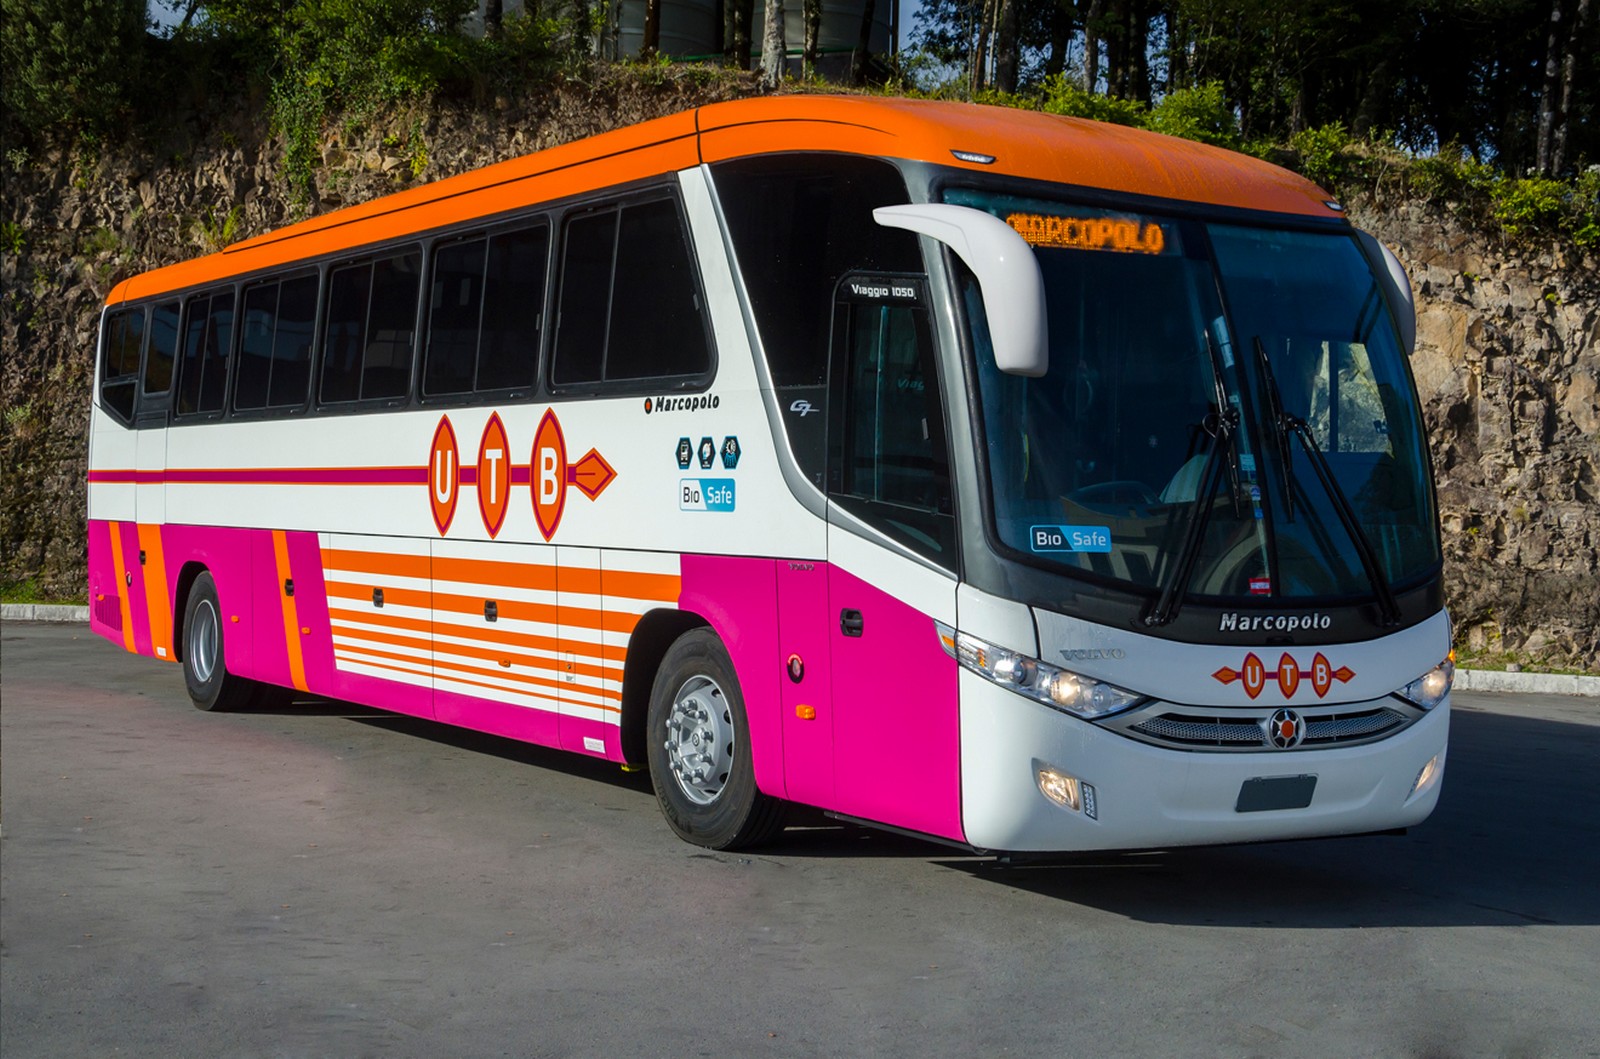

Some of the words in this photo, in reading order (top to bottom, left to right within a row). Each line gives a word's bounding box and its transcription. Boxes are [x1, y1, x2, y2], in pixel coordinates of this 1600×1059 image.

[851, 284, 889, 298] Viaggio
[891, 287, 914, 298] 1050
[655, 393, 720, 412] Marcopolo
[707, 486, 732, 504] Safe
[1072, 532, 1106, 546] Safe
[1219, 613, 1331, 632] Marcopolo
[1059, 648, 1127, 661] VOLVO
